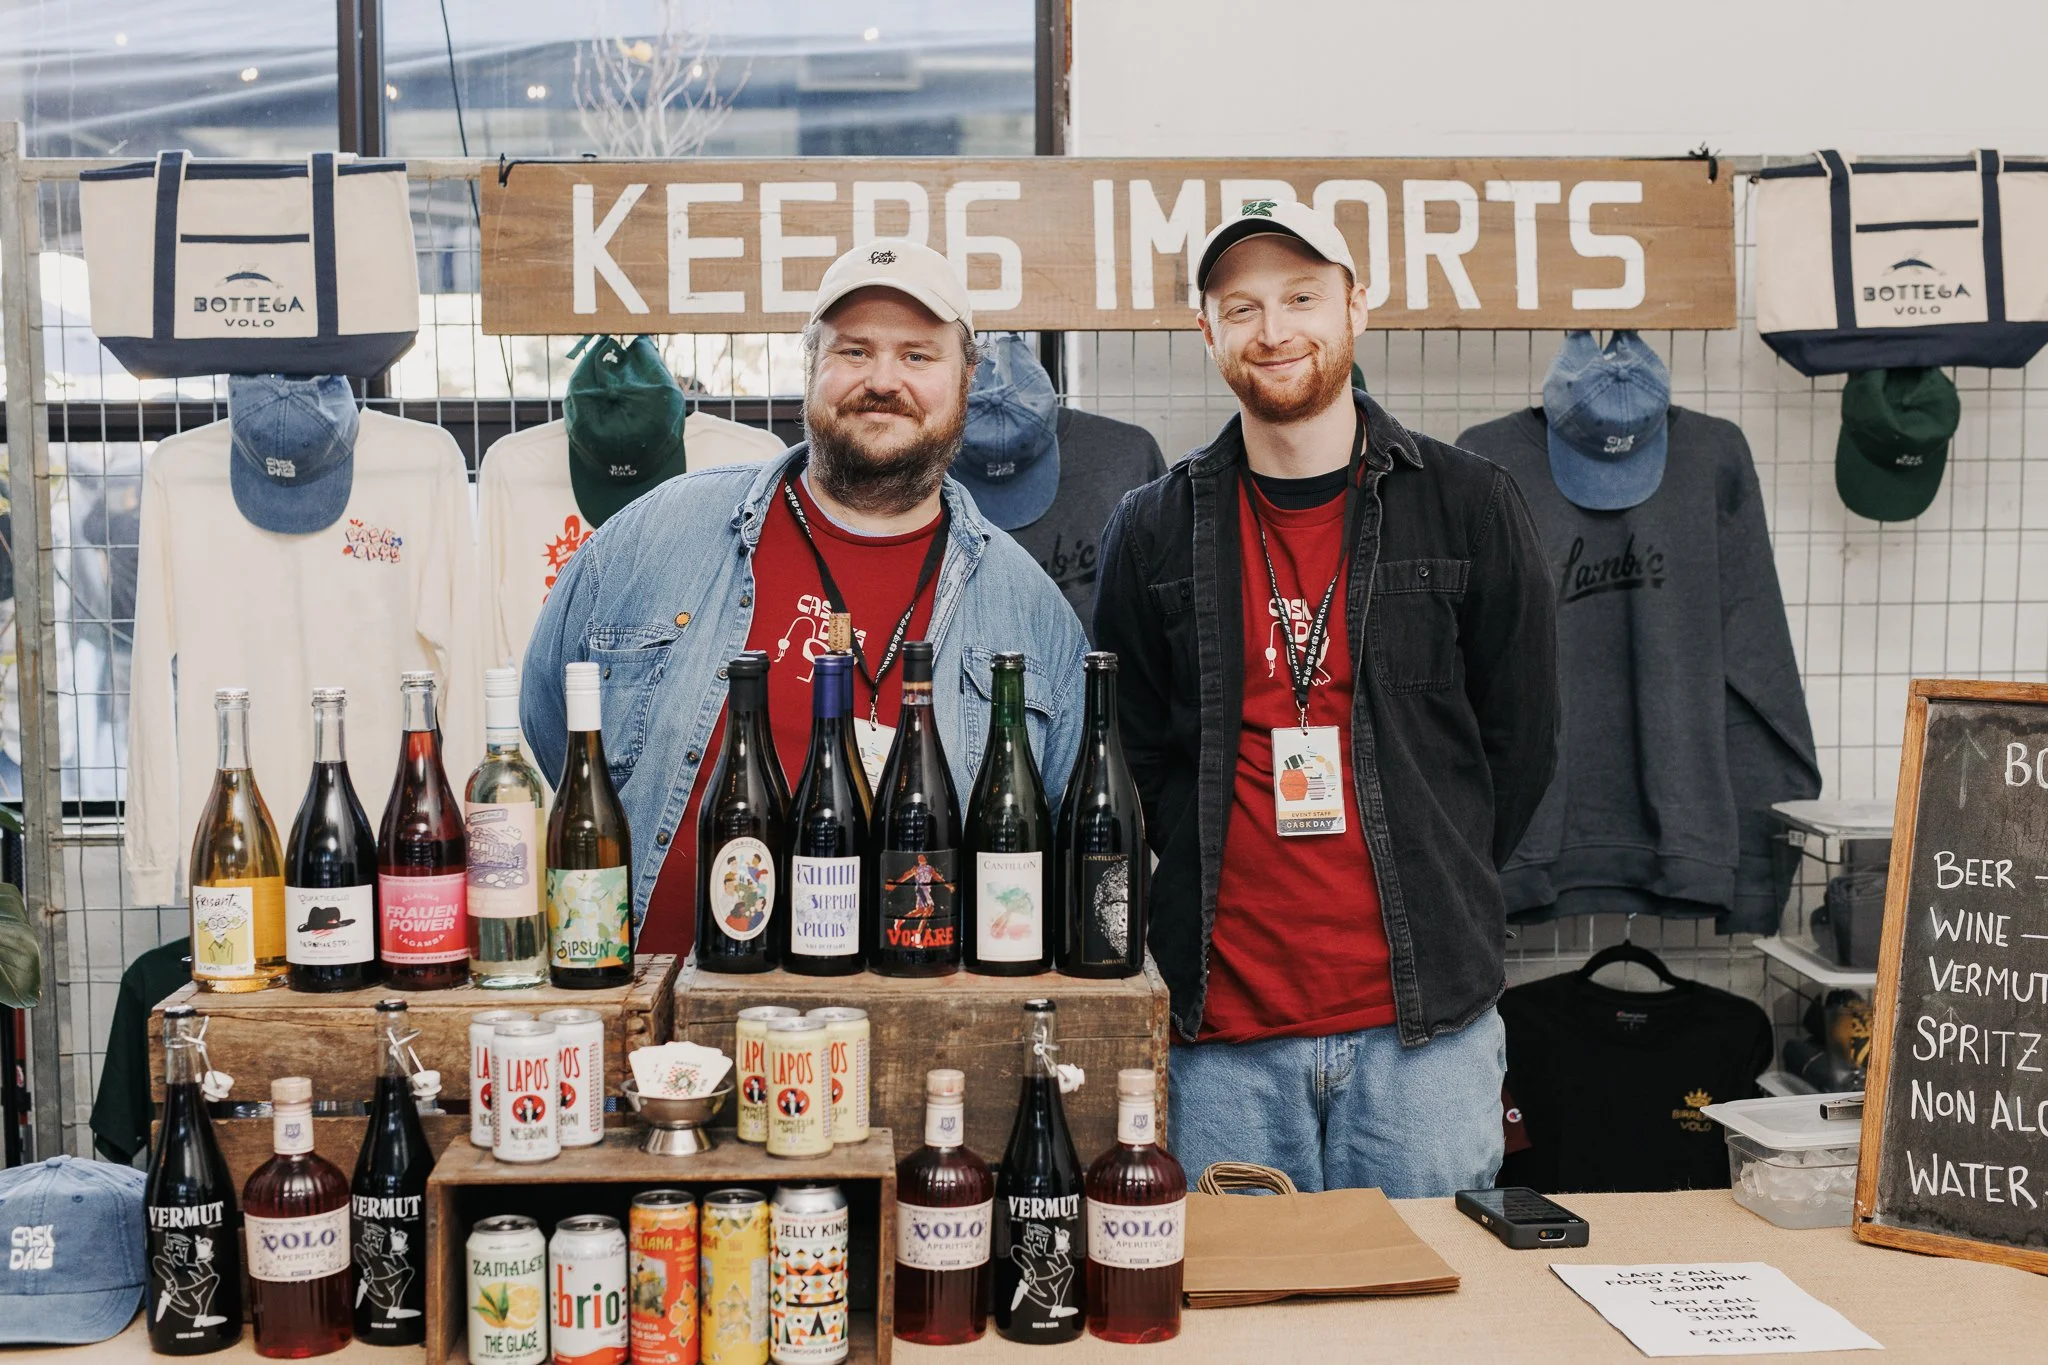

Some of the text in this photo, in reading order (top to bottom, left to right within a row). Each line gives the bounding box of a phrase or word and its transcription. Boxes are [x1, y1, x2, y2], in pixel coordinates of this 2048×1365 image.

[572, 181, 1023, 315] KEEP6
[193, 295, 305, 312] BOTTEGA
[1863, 284, 1971, 301] BOTTEGA
[1894, 305, 1941, 315] VOLO
[224, 318, 275, 327] VOLO
[797, 595, 833, 617] CAS
[1933, 850, 2016, 890] BEER
[386, 903, 458, 919] FRAUEN
[388, 917, 455, 932] POWER
[1929, 906, 2011, 948] WINE
[886, 926, 955, 947] VOLARE
[1912, 1015, 2043, 1072] SPRITZ
[1910, 1079, 1976, 1124] NON
[1906, 1150, 2038, 1210] WATER
[149, 1201, 224, 1229] VERMUT
[352, 1195, 422, 1220] VERMUT
[1008, 1194, 1080, 1220] VERMUT
[11, 1224, 56, 1248] CASK
[780, 1224, 816, 1238] JELLY
[1617, 1271, 1664, 1279] LAST
[1691, 1275, 1752, 1283] DRINK
[558, 1264, 619, 1329] brio
[1671, 1305, 1756, 1313] TOKENS
